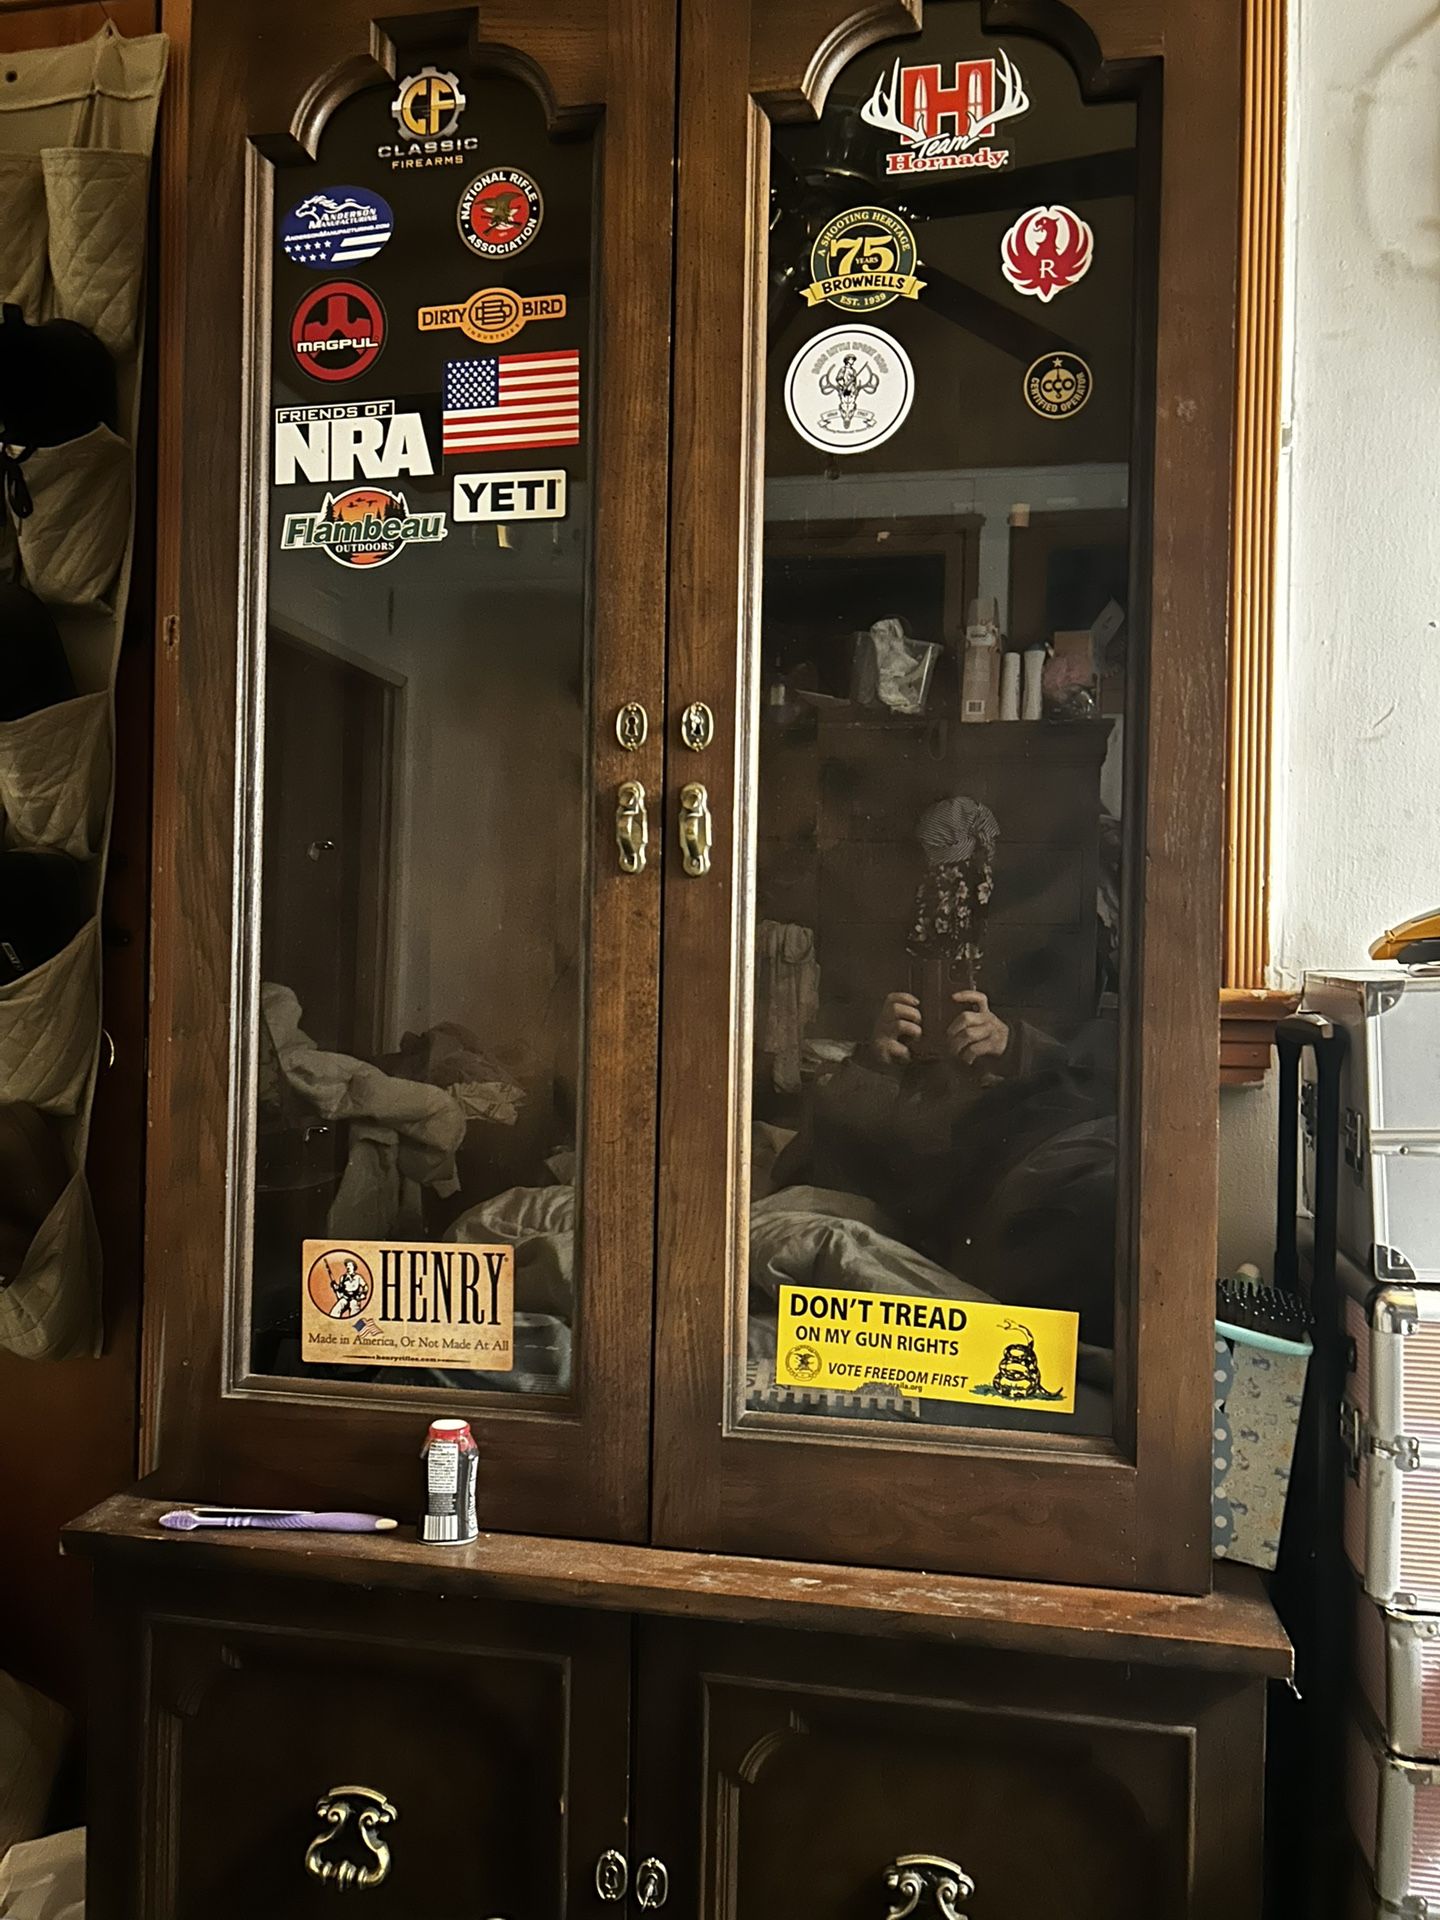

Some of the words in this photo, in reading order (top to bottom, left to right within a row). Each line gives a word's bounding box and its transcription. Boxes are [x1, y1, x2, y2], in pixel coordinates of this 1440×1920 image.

[377, 137, 479, 158] CLASSIC
[911, 132, 980, 159] Team
[392, 155, 464, 169] FIREARMS
[886, 147, 1009, 175] Hornady
[460, 171, 507, 220] NATIONAL
[509, 172, 538, 202] RIFLE
[308, 215, 378, 229] MANUFACTURING
[320, 208, 377, 221] ANDERSON
[467, 218, 538, 254] ASSOCIATION
[821, 211, 869, 247] SHOOTING
[871, 212, 911, 252] HERITAGE
[830, 235, 895, 275] 75
[855, 256, 879, 265] YEARS
[1039, 259, 1057, 279] R
[821, 275, 906, 294] BROWNELLS
[422, 308, 467, 326] DIRTY
[522, 299, 563, 317] BIRD
[840, 295, 861, 306] EST.
[297, 337, 379, 353] MAGPUL
[1030, 377, 1058, 412] CERTIFIED
[1060, 371, 1087, 411] OPERATOR
[279, 407, 358, 423] FRIENDS
[364, 402, 391, 416] OF
[275, 412, 434, 485] NRA
[459, 478, 557, 513] YETI
[284, 513, 443, 546] Flambeau
[335, 542, 395, 553] OUTDOORS
[378, 1249, 507, 1326] HENRY
[790, 1293, 873, 1323] DON'T
[879, 1300, 968, 1332] TREAD
[307, 1332, 338, 1345] Made
[340, 1334, 350, 1345] in
[352, 1334, 398, 1348] America,
[400, 1335, 416, 1347] Or
[418, 1336, 440, 1348] Not
[442, 1337, 471, 1350] Made
[474, 1338, 489, 1351] At
[492, 1338, 510, 1352] All
[795, 1325, 820, 1342] ON
[825, 1328, 851, 1345] MY
[855, 1331, 893, 1349] GUN
[897, 1335, 960, 1356] RIGHTS
[828, 1362, 863, 1378] VOTE
[863, 1365, 929, 1385] FREEDOM
[931, 1372, 969, 1389] FIRST
